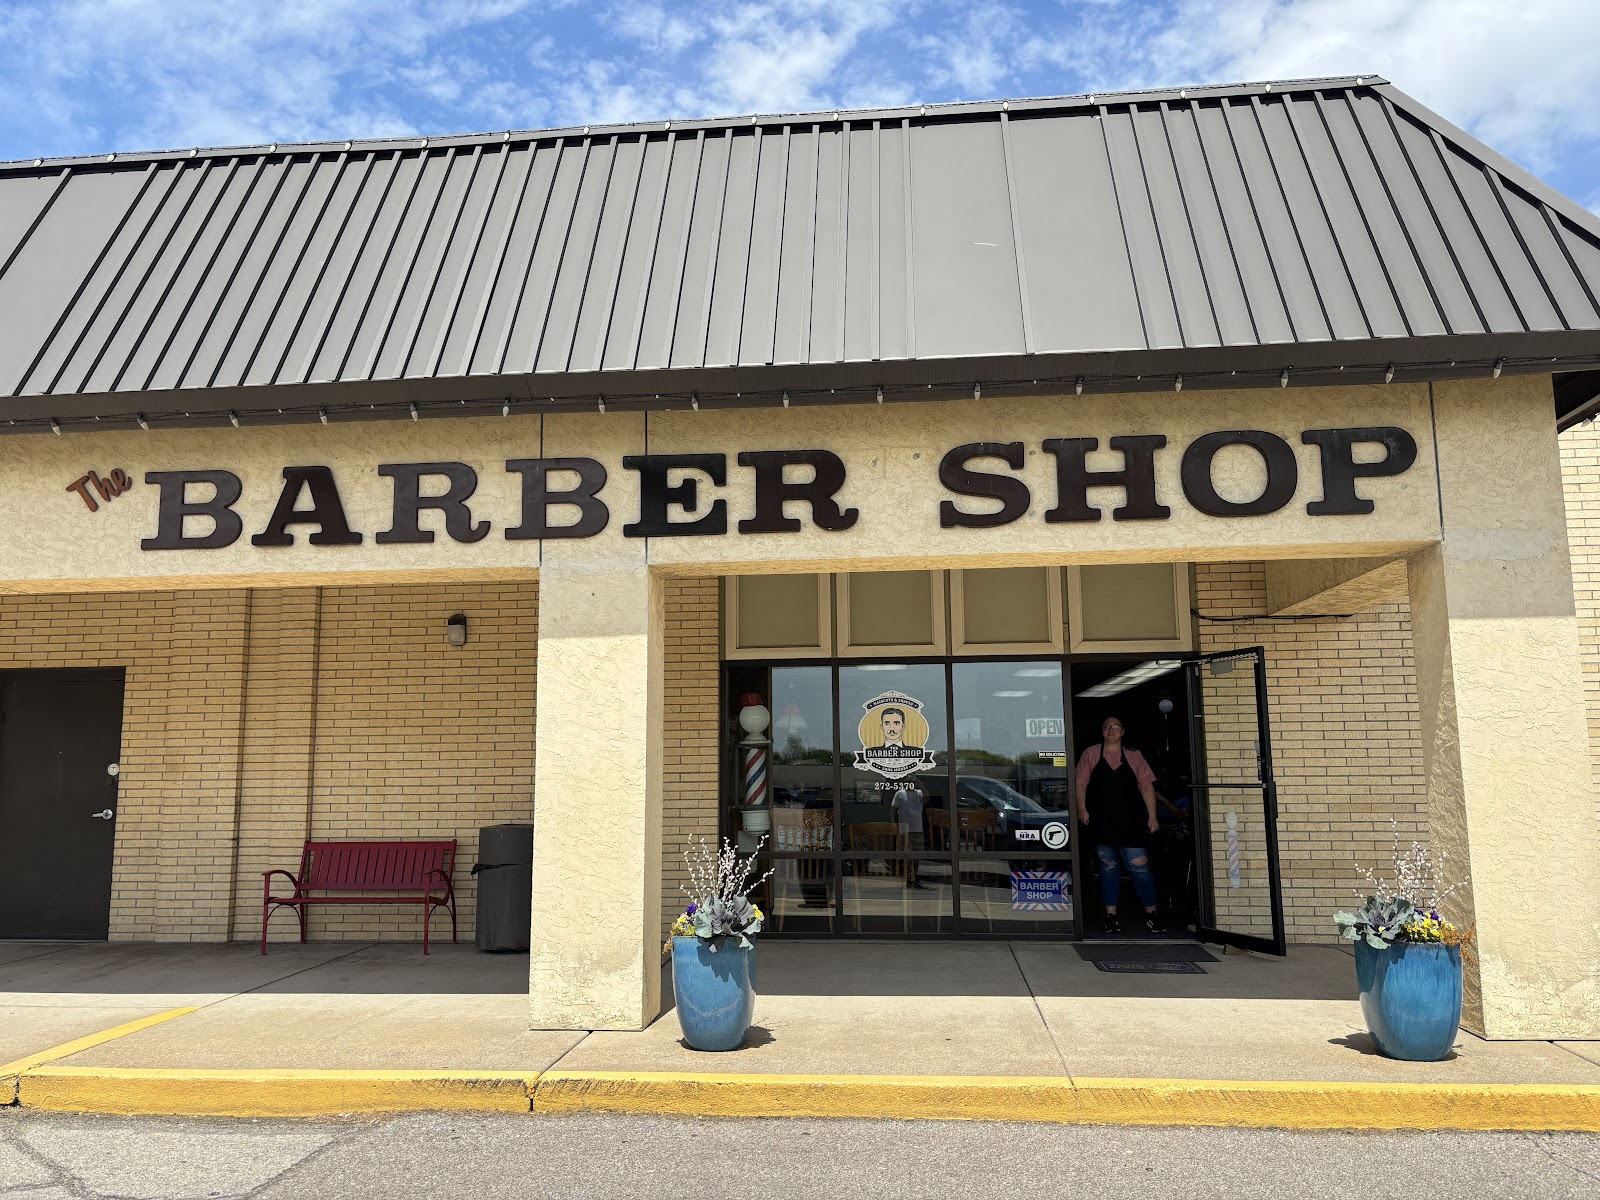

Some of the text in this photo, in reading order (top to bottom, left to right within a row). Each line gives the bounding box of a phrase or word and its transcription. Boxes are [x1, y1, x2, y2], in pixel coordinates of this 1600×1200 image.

[66, 426, 1417, 551] The BARBER SHOP
[1029, 720, 1063, 735] OPEN
[874, 782, 915, 790] 272-5370
[1020, 882, 1059, 891] BARBER
[1026, 891, 1053, 900] SHOP
